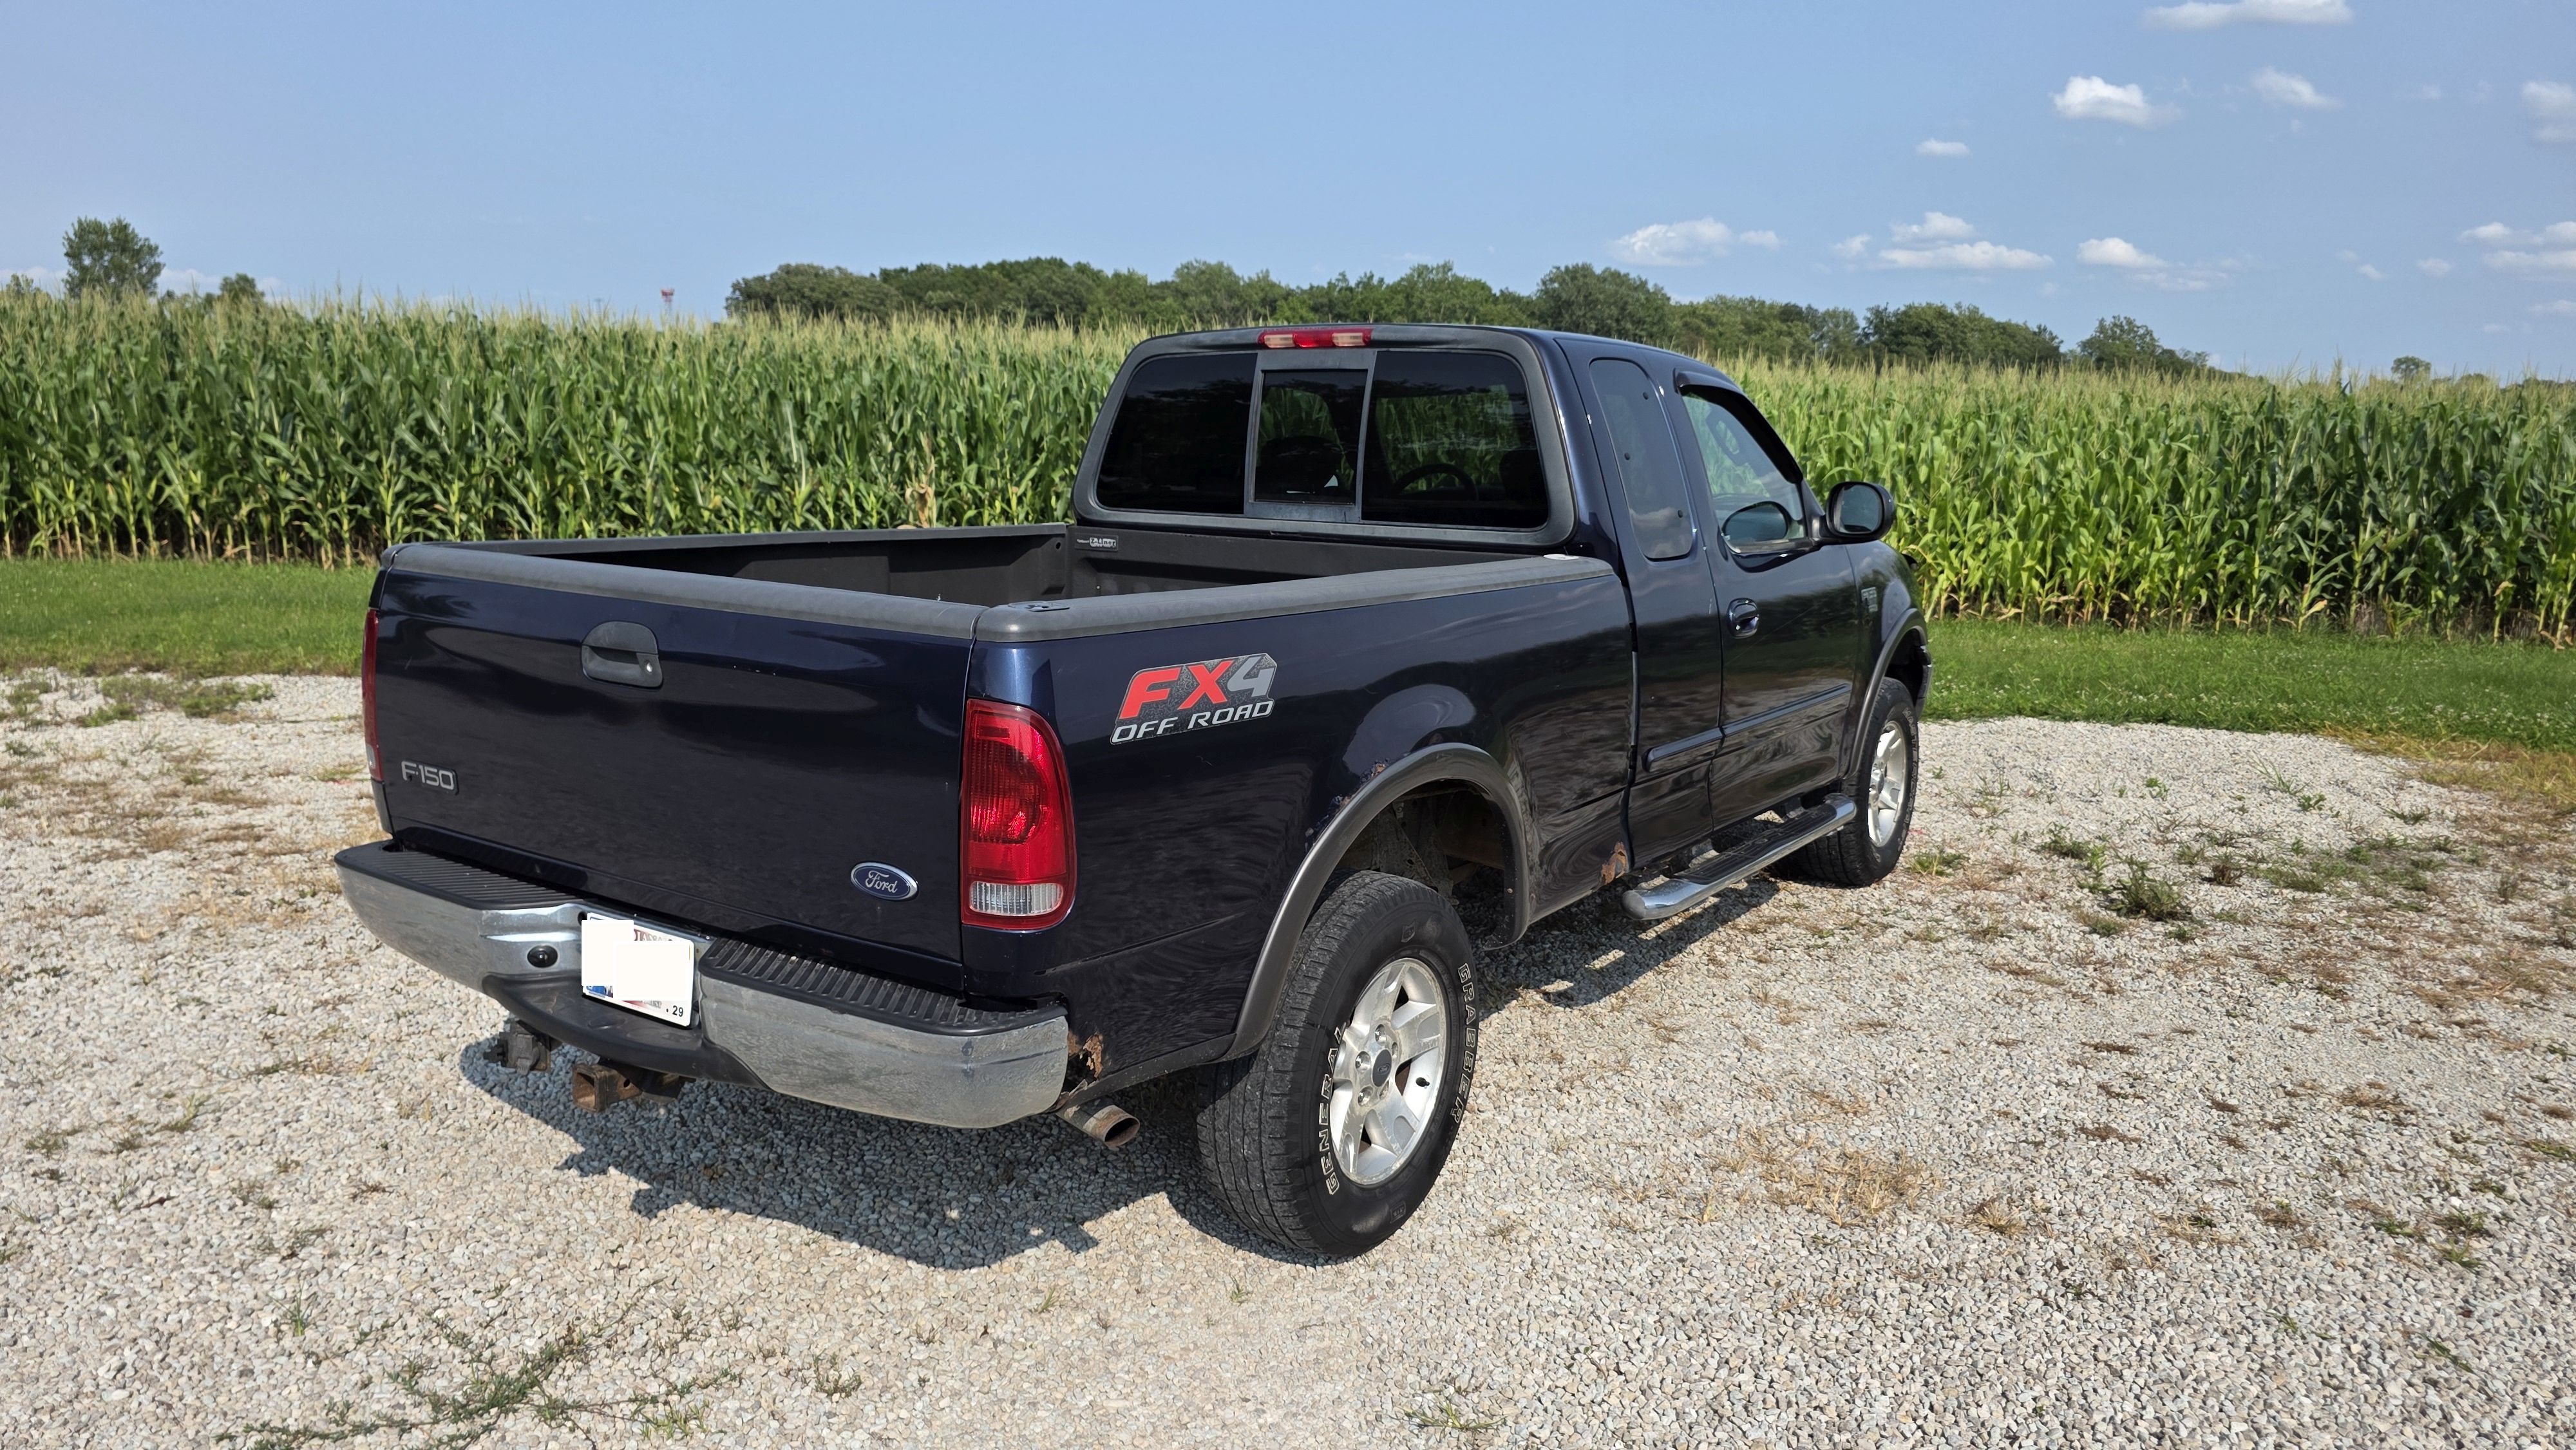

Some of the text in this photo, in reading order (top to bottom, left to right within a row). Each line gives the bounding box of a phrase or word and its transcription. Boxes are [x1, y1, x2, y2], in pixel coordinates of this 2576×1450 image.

[1119, 656, 1274, 720] FX4
[1112, 701, 1274, 743] OFF ROAD
[865, 870, 898, 893] Ford
[672, 1005, 684, 1017] 29
[1451, 963, 1476, 1124] GRABBER
[1319, 1022, 1347, 1196] GENERAL
